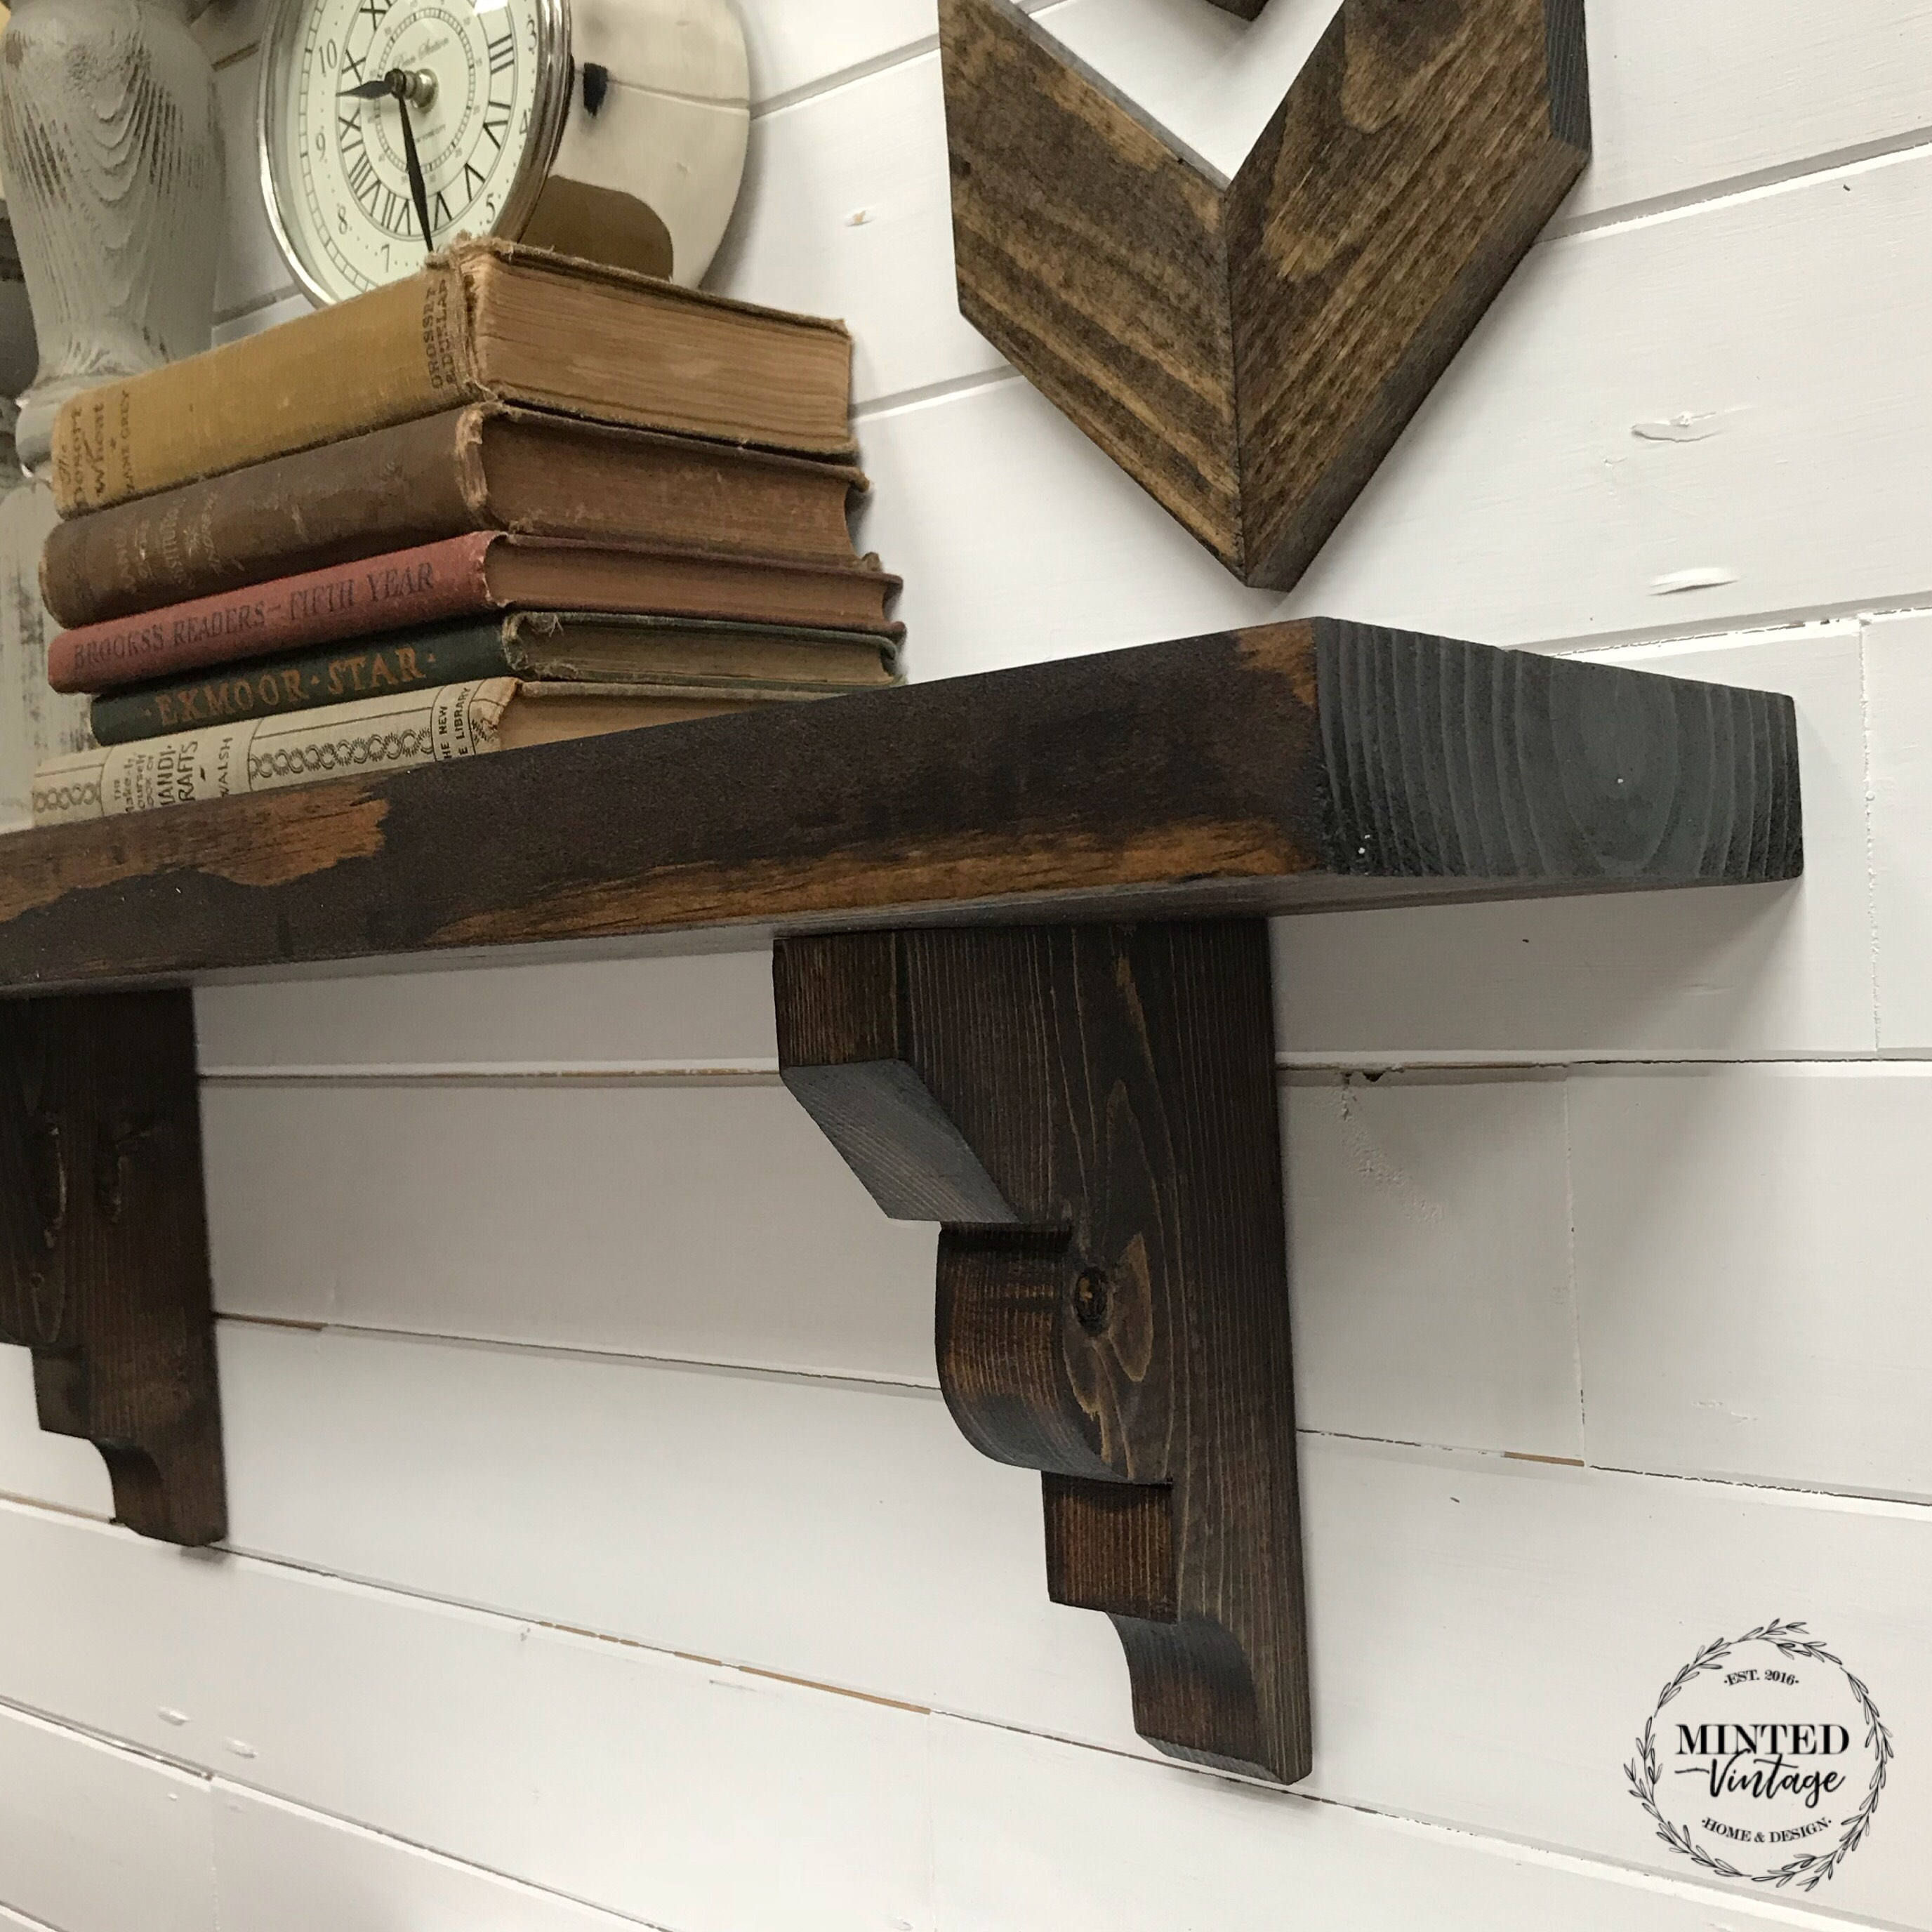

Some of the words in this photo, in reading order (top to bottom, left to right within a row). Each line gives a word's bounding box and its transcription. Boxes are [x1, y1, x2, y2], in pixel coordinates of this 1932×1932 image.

[488, 33, 515, 75] III
[527, 19, 538, 54] 3
[319, 39, 338, 77] 10
[342, 48, 366, 86] X
[338, 106, 364, 153] IX
[482, 100, 512, 150] IV
[315, 132, 326, 163] 9
[349, 151, 381, 218] VIII
[464, 162, 487, 203] V
[336, 204, 349, 235] 8
[487, 192, 496, 225] 5
[381, 244, 390, 274] 7
[173, 600, 265, 645] READERS
[290, 579, 355, 621] FIFTH
[367, 562, 434, 602] YEAR
[154, 668, 310, 727] EXMOOR
[326, 647, 427, 696] STAR
[438, 706, 449, 736] NEW
[454, 687, 471, 741] LIBRARY
[176, 741, 199, 802] RAFTS
